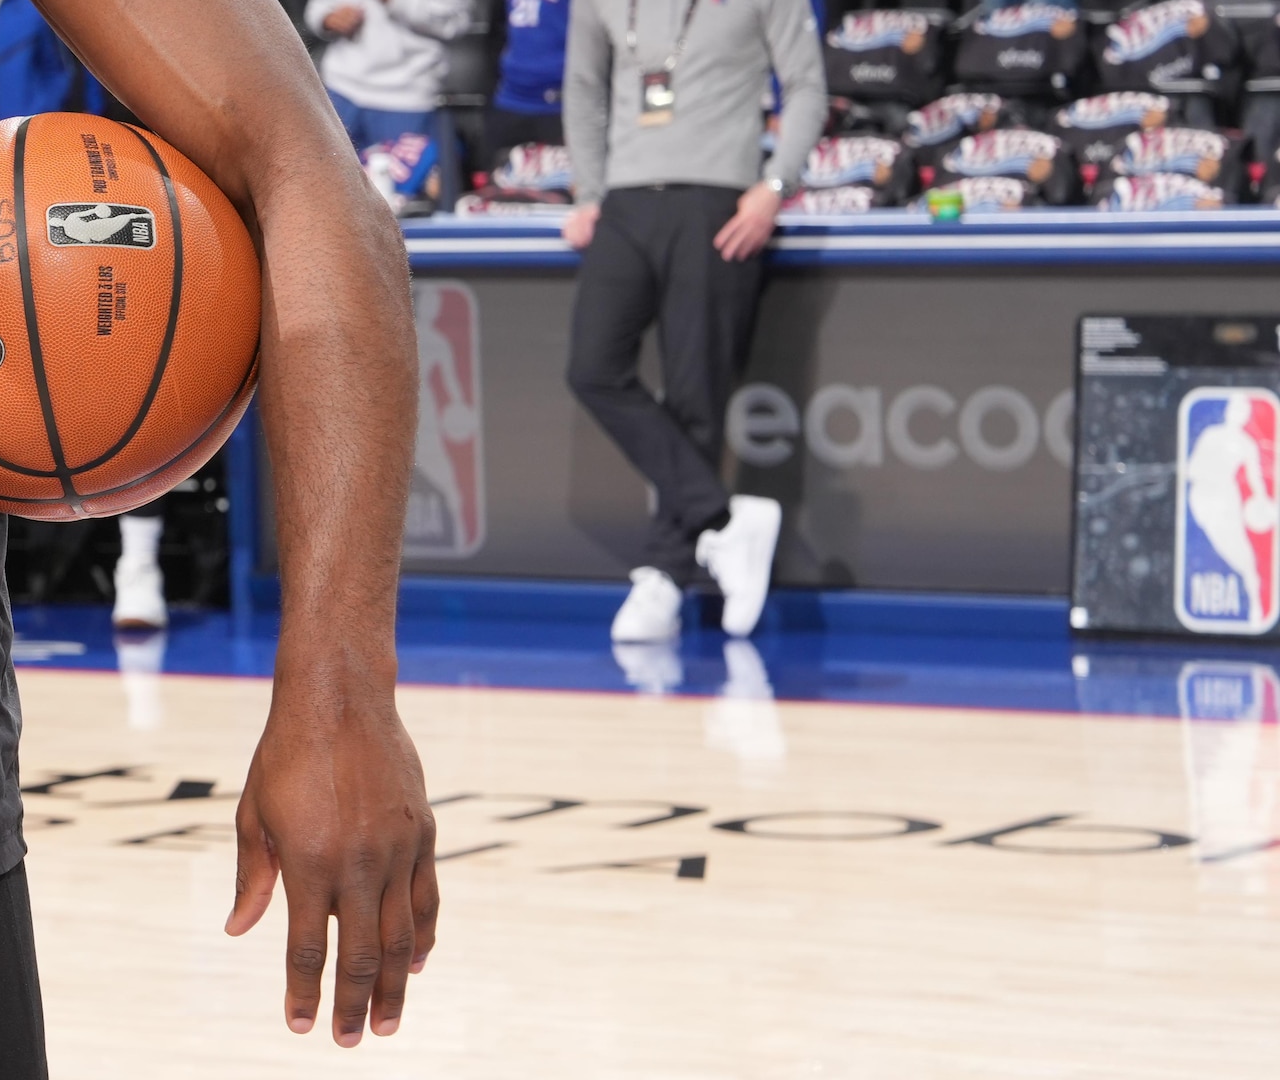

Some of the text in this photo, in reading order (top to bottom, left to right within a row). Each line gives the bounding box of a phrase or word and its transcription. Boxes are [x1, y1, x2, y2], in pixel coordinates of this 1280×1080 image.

[86, 150, 105, 178] TRAINING
[131, 221, 150, 244] NBA
[98, 265, 113, 282] LBS
[96, 291, 113, 336] WEIGHTED
[115, 282, 127, 321] OFFICIAL SIZE
[1190, 571, 1241, 617] NBA
